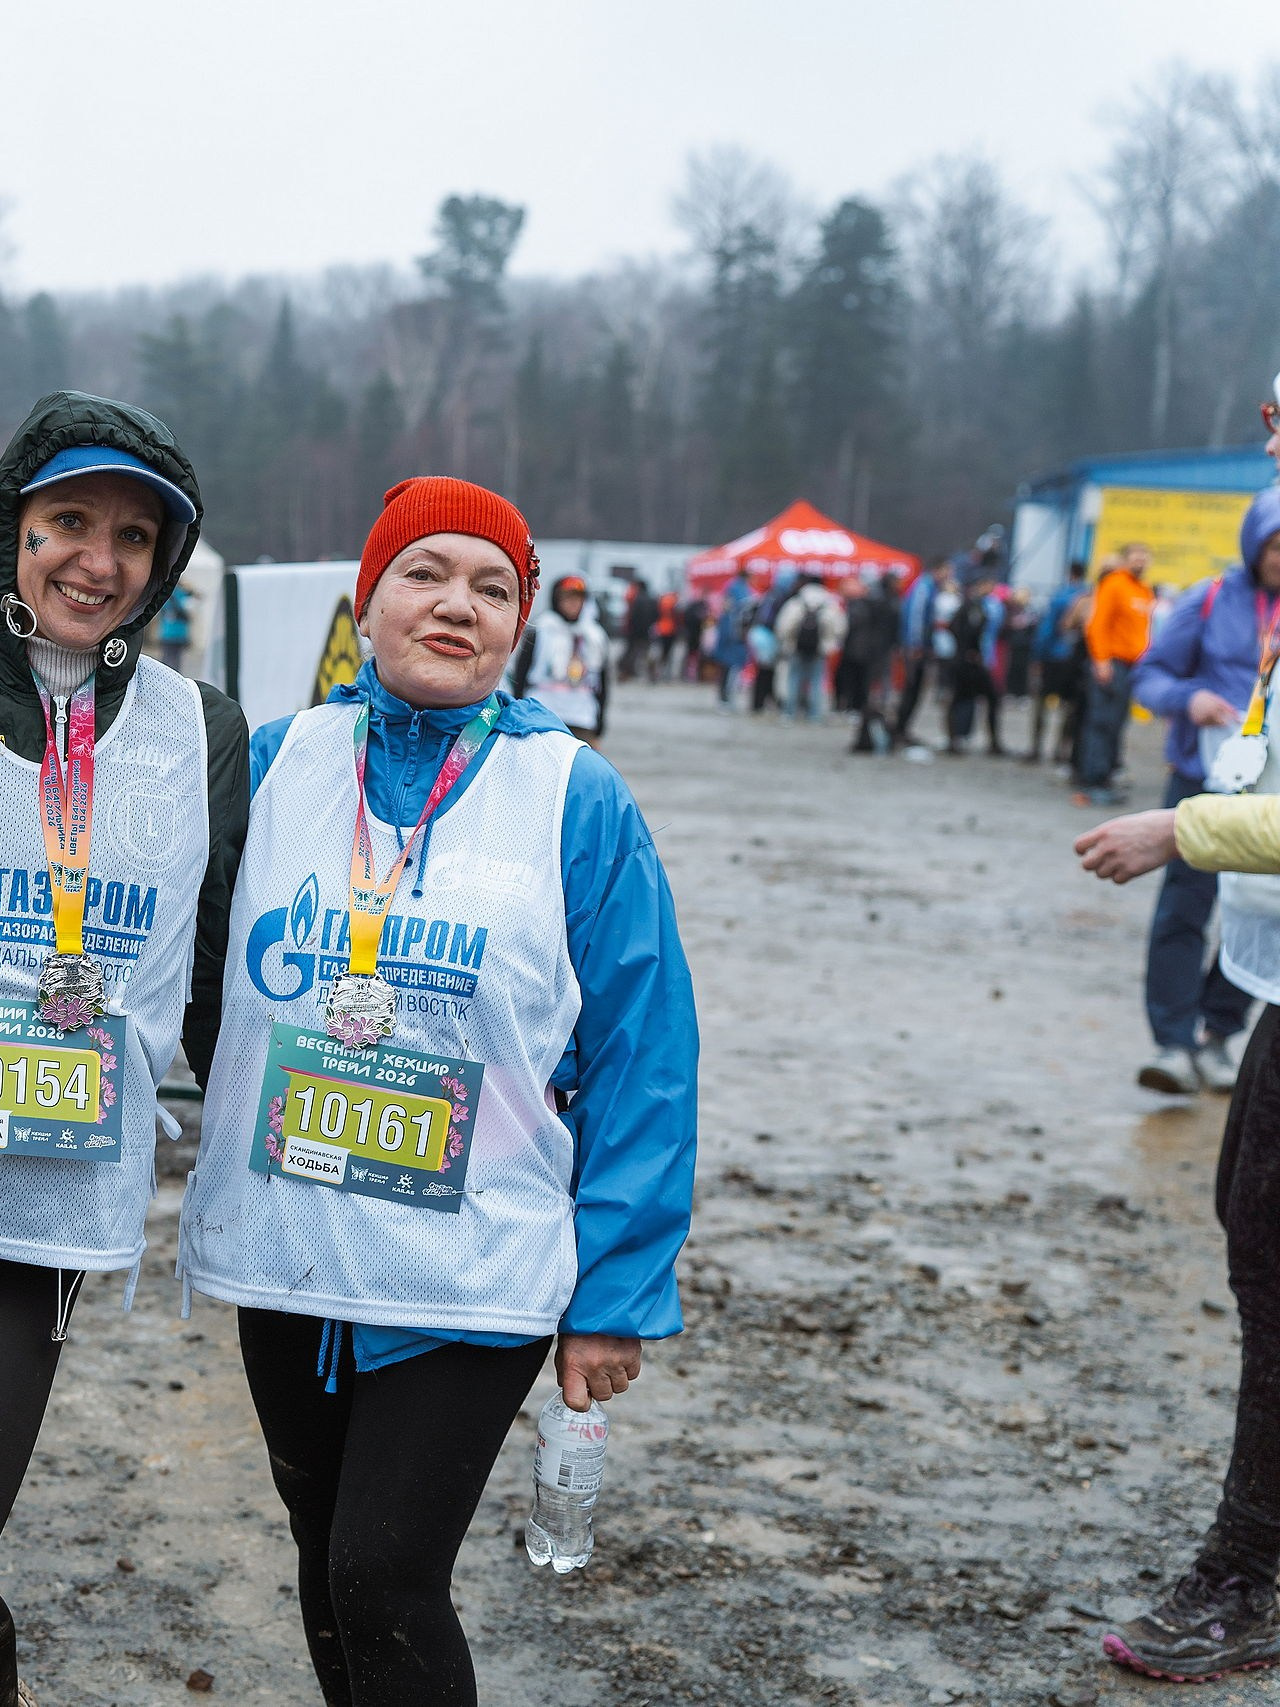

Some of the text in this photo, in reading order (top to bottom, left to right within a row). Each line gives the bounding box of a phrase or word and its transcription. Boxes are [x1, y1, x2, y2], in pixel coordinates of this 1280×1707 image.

[44, 776, 56, 827] 18.04.2026
[70, 760, 81, 856] ЦВЕТЫ БАГУЛЬНИКА
[79, 782, 88, 833] 18.04.2026
[320, 908, 488, 970] ГАПРОМ
[322, 959, 474, 992] ГАЗСПРЕДЕЛЕНИЕ
[408, 995, 470, 1021] ВОСТОК
[296, 1035, 450, 1076] ВЕСЕННИЙ ХЕХЦИР
[322, 1056, 418, 1087] ТРЕЙЛ 2026
[295, 1085, 433, 1158] 10161
[288, 1154, 340, 1175] ХОДЬБА
[290, 1145, 342, 1161] СКАНДИНАВСКАЯ
